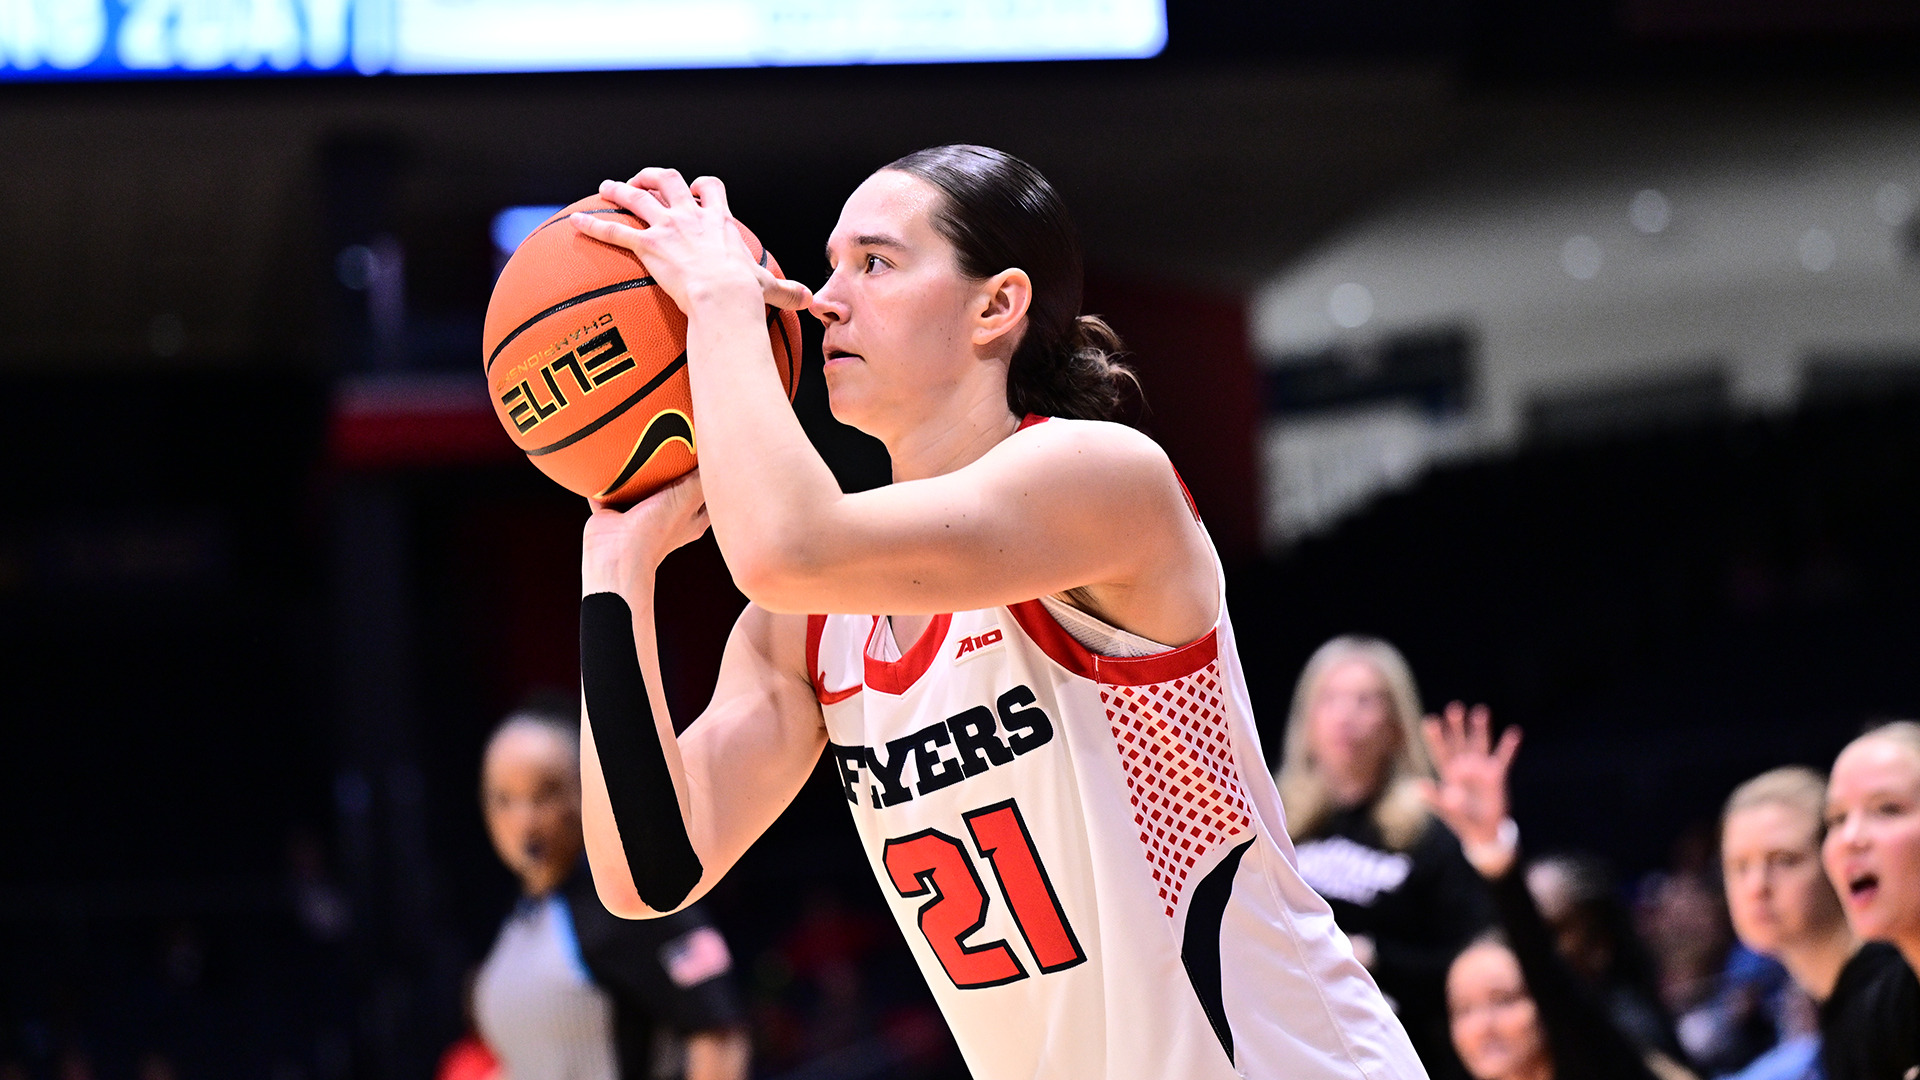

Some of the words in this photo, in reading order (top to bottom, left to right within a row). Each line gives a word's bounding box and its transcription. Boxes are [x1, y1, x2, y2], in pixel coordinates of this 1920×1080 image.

[500, 326, 637, 436] ELITE
[830, 684, 1054, 809] FYERS
[882, 797, 1088, 990] 21
